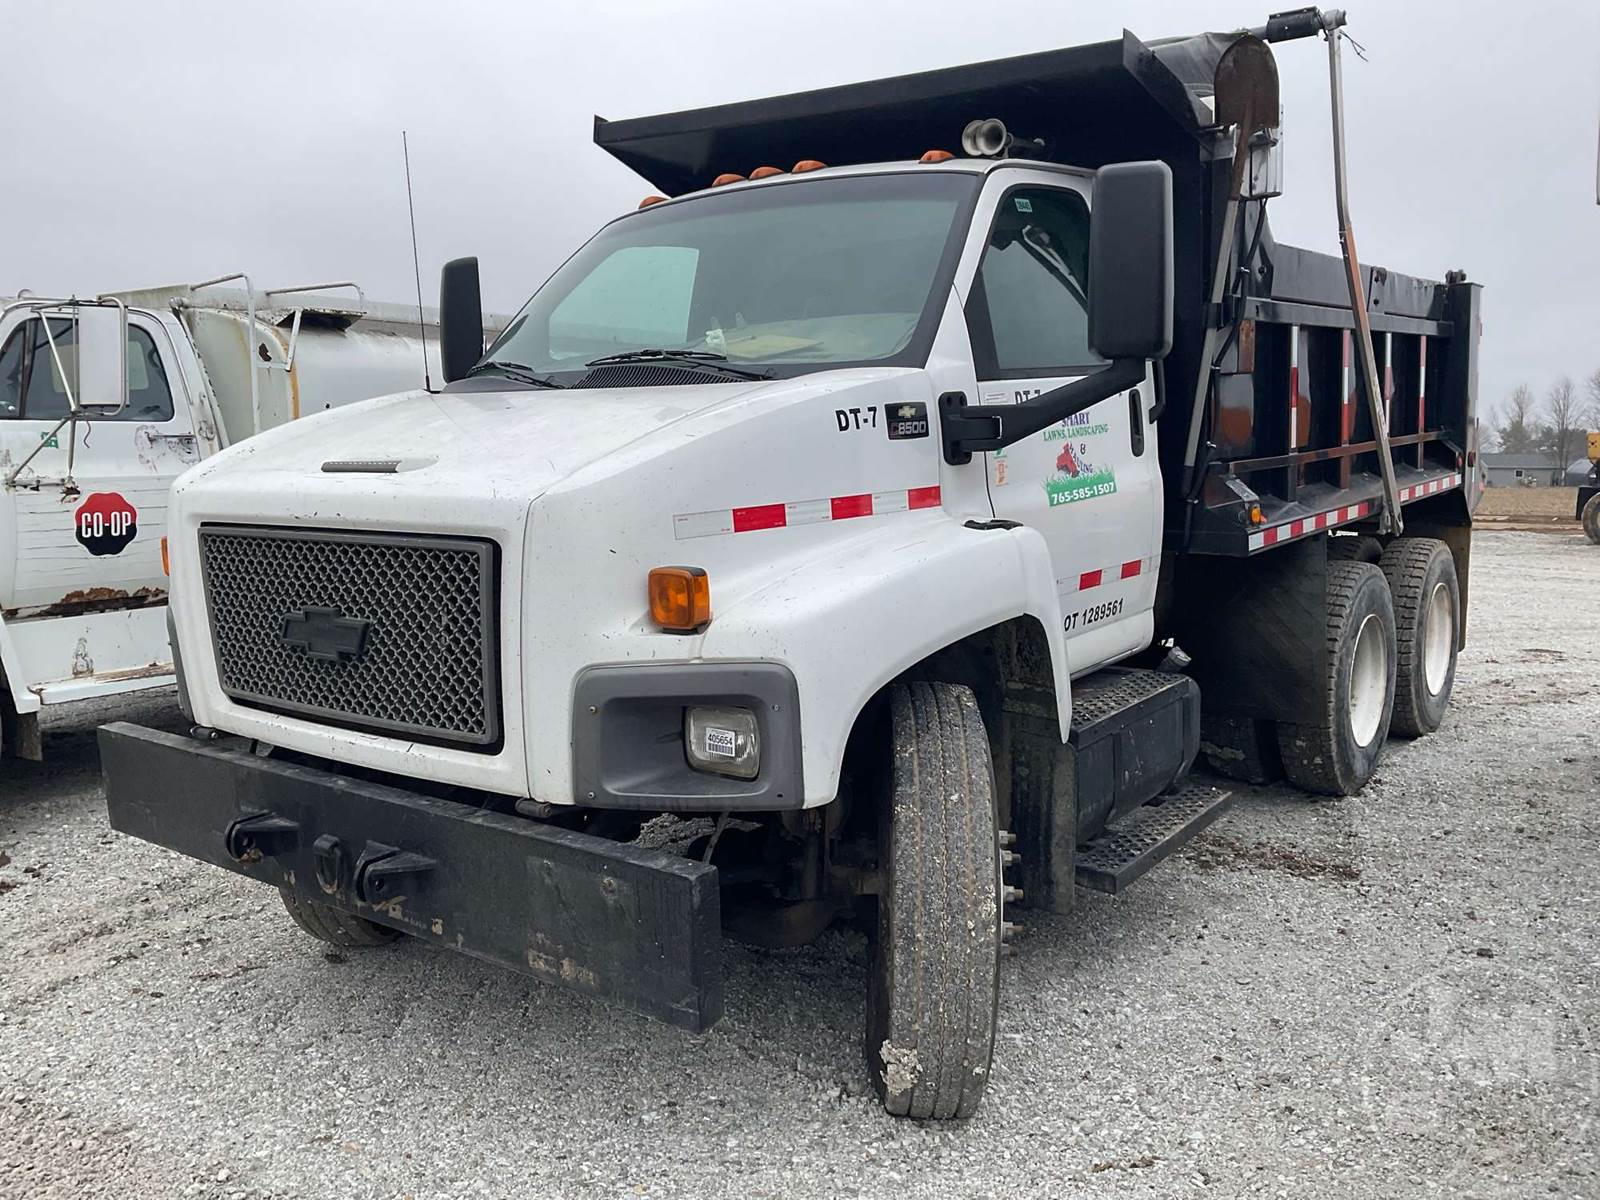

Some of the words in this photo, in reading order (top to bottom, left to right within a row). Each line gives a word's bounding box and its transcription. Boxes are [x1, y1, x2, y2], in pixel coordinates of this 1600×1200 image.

[835, 406, 877, 431] DT-7
[890, 420, 927, 436] C8500
[1067, 424, 1108, 438] LANDSCAPING
[1080, 443, 1086, 455] &
[1052, 482, 1115, 504] 765-585-1507
[81, 511, 131, 538] CO-OP
[1082, 598, 1123, 626] 1289561
[708, 734, 732, 745] 405654
